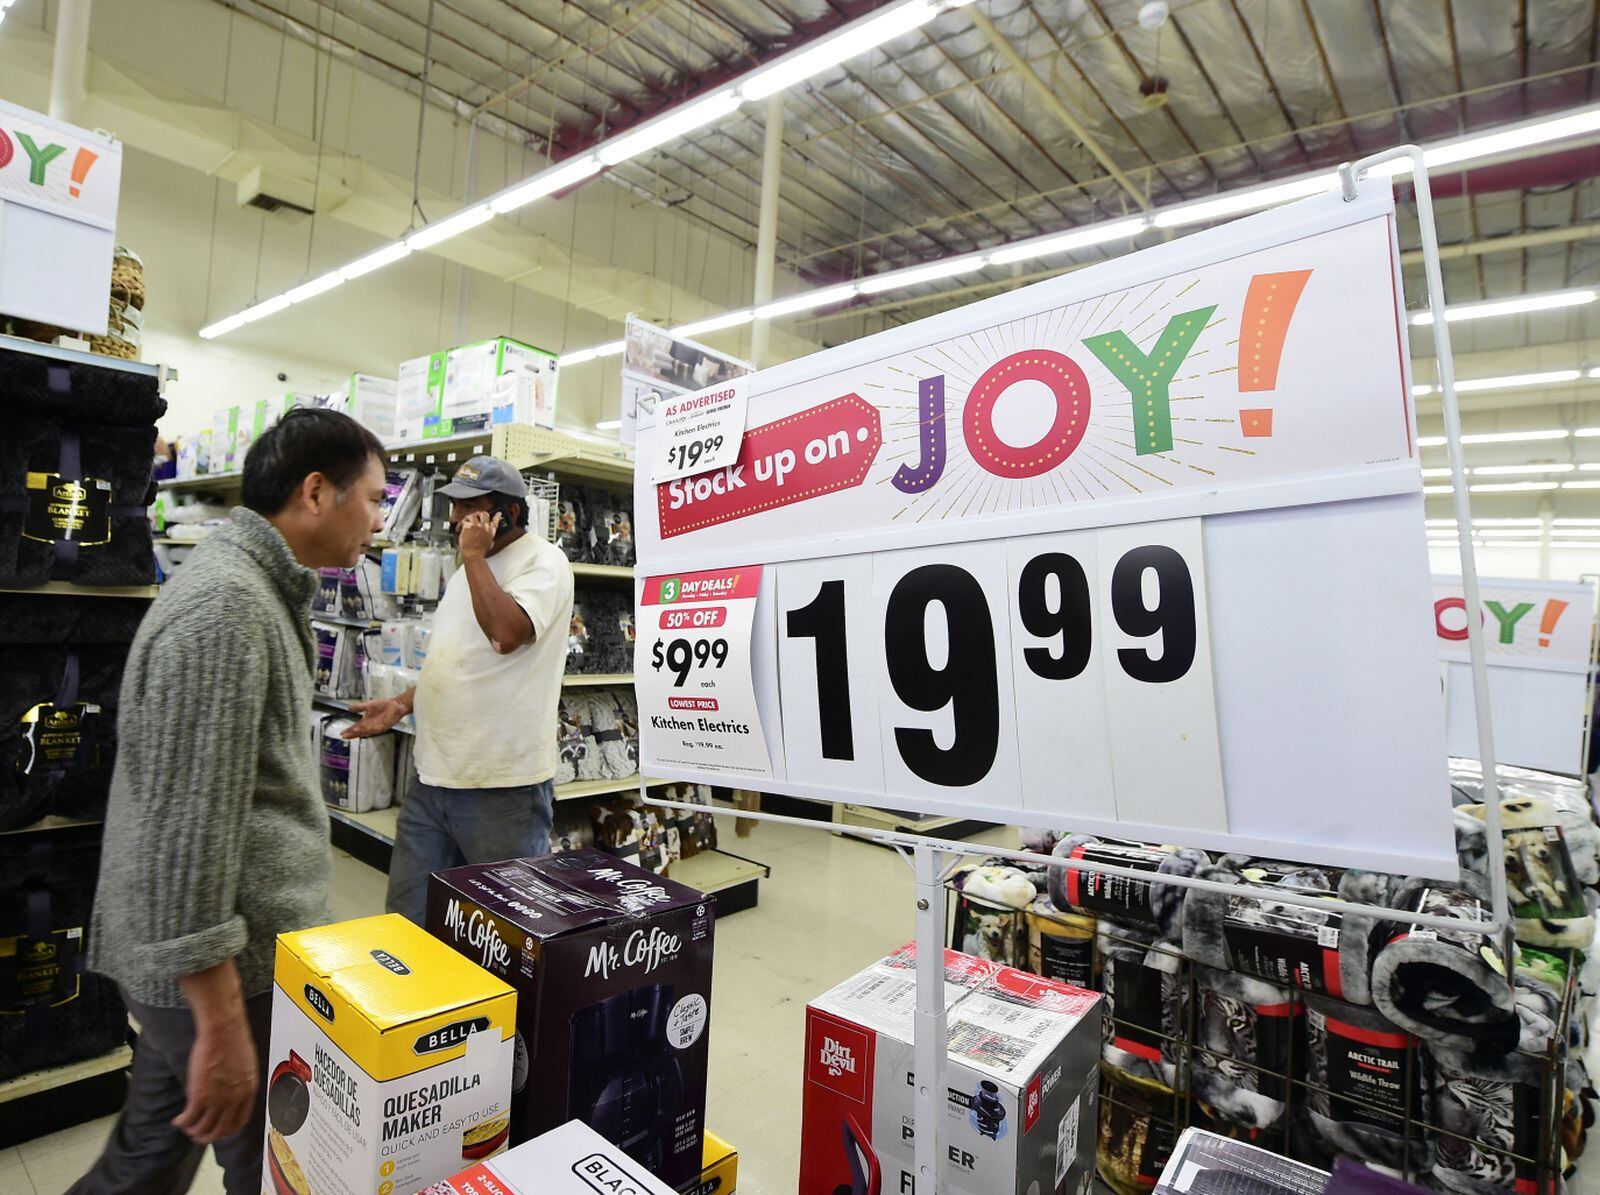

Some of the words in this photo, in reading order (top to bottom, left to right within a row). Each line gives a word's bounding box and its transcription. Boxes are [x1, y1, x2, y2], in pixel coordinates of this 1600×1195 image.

[890, 269, 1313, 495] JOY!
[666, 407, 677, 417] AS
[679, 388, 736, 414] ADVERTISED
[674, 424, 696, 438] Kitchen
[697, 419, 721, 433] Electrics
[669, 464, 747, 510] Stock
[754, 449, 796, 487] up
[805, 430, 849, 466] on
[47, 506, 91, 517] BLANKET
[664, 582, 675, 600] 3
[682, 580, 701, 593] DAY
[701, 574, 741, 594] DEALS!
[666, 611, 690, 628] 50%
[693, 610, 719, 627] OFF
[1434, 597, 1569, 648] OY!
[700, 680, 716, 688] each
[670, 699, 696, 709] LOWEST
[697, 700, 716, 710] PRICE
[651, 716, 694, 731] Kitchen
[697, 718, 750, 735] Electrics
[40, 736, 82, 746] BLANKET
[445, 898, 466, 942] Mr.
[468, 910, 511, 969] Coffee
[376, 953, 404, 973] BELLA
[584, 942, 621, 980] Mr.
[624, 927, 682, 974] Coffee
[309, 989, 329, 1017] BELLA
[429, 1022, 479, 1048] BELLA
[680, 1034, 693, 1045] BREW
[824, 1036, 851, 1059] Dirt
[315, 1042, 346, 1089] HACEDOR
[347, 1076, 358, 1102] DE
[820, 1049, 857, 1073] Devil
[1348, 1050, 1377, 1066] ARCTIC
[1377, 1058, 1401, 1070] TRAIL
[1349, 1070, 1377, 1085] Wildlife
[1378, 1078, 1400, 1090] Throw
[313, 1065, 361, 1127] QUESADILLAS
[383, 1073, 480, 1119] QUESADILLA
[381, 1138, 415, 1157] QUICK
[417, 1128, 440, 1144] AND
[442, 1119, 467, 1135] EASY
[467, 1111, 480, 1122] TO
[482, 1102, 499, 1118] USE
[382, 1104, 442, 1142] MAKER
